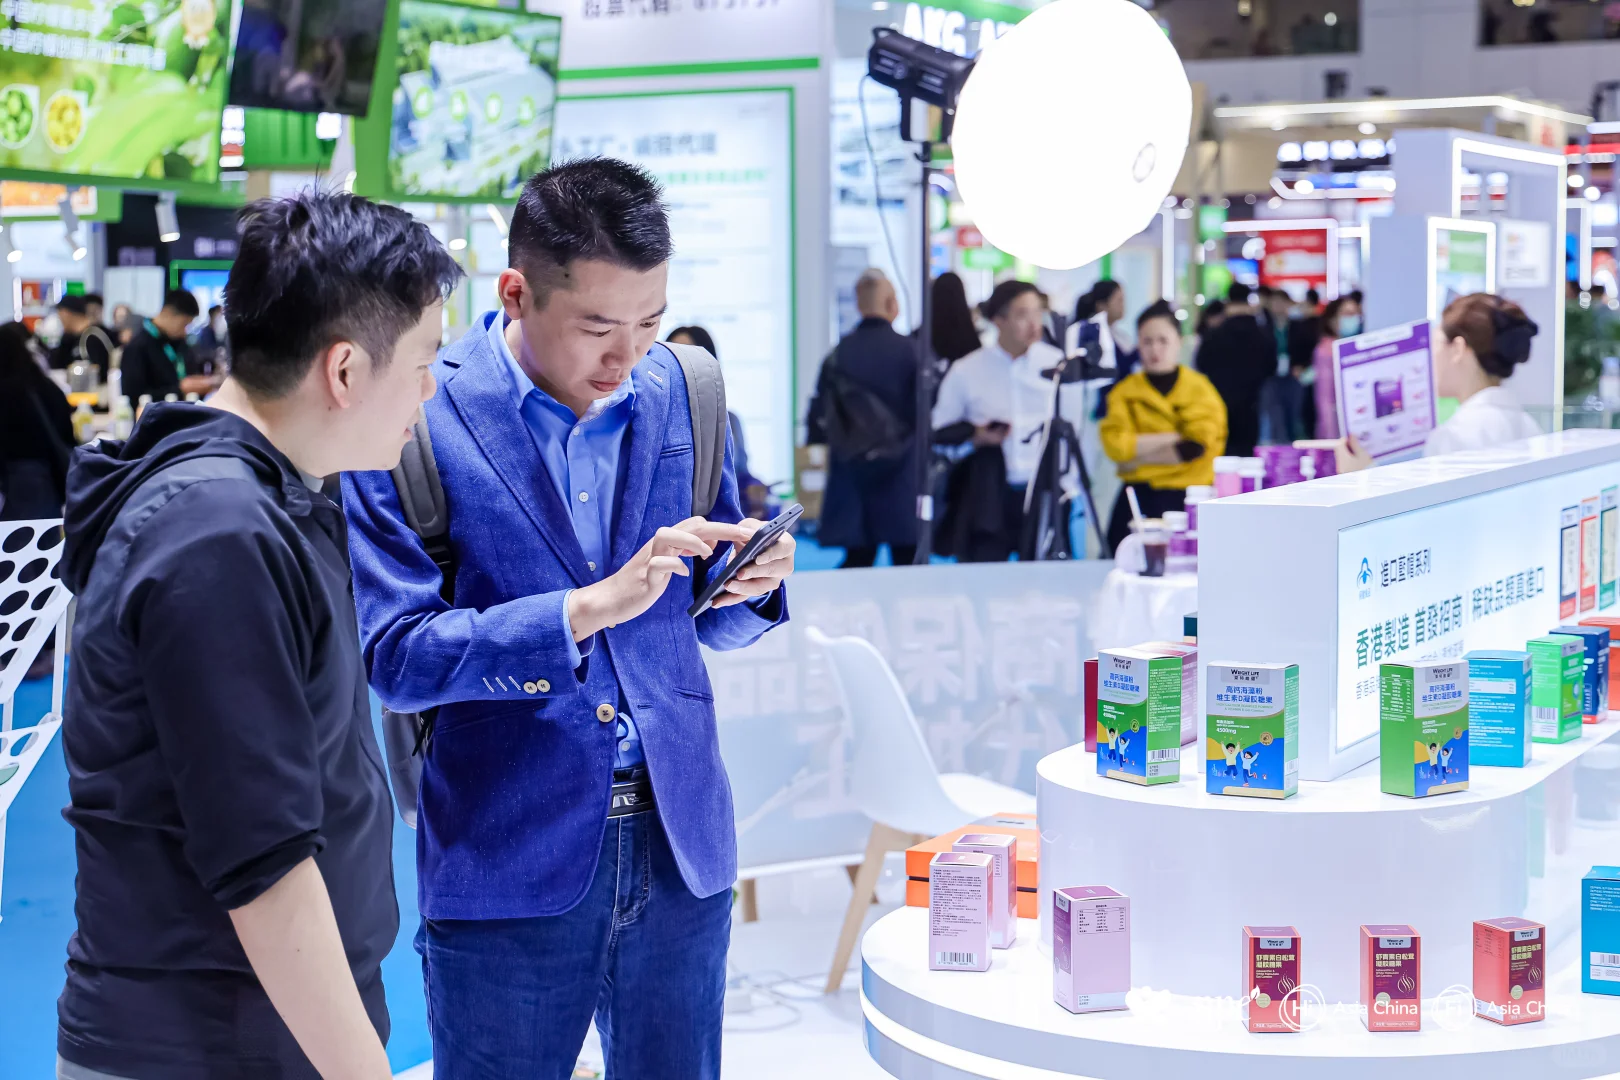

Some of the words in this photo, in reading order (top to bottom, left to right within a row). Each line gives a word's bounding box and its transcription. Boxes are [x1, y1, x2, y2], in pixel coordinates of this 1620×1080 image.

[1357, 613, 1410, 669] 香港製造
[1415, 594, 1463, 646] 首發招商
